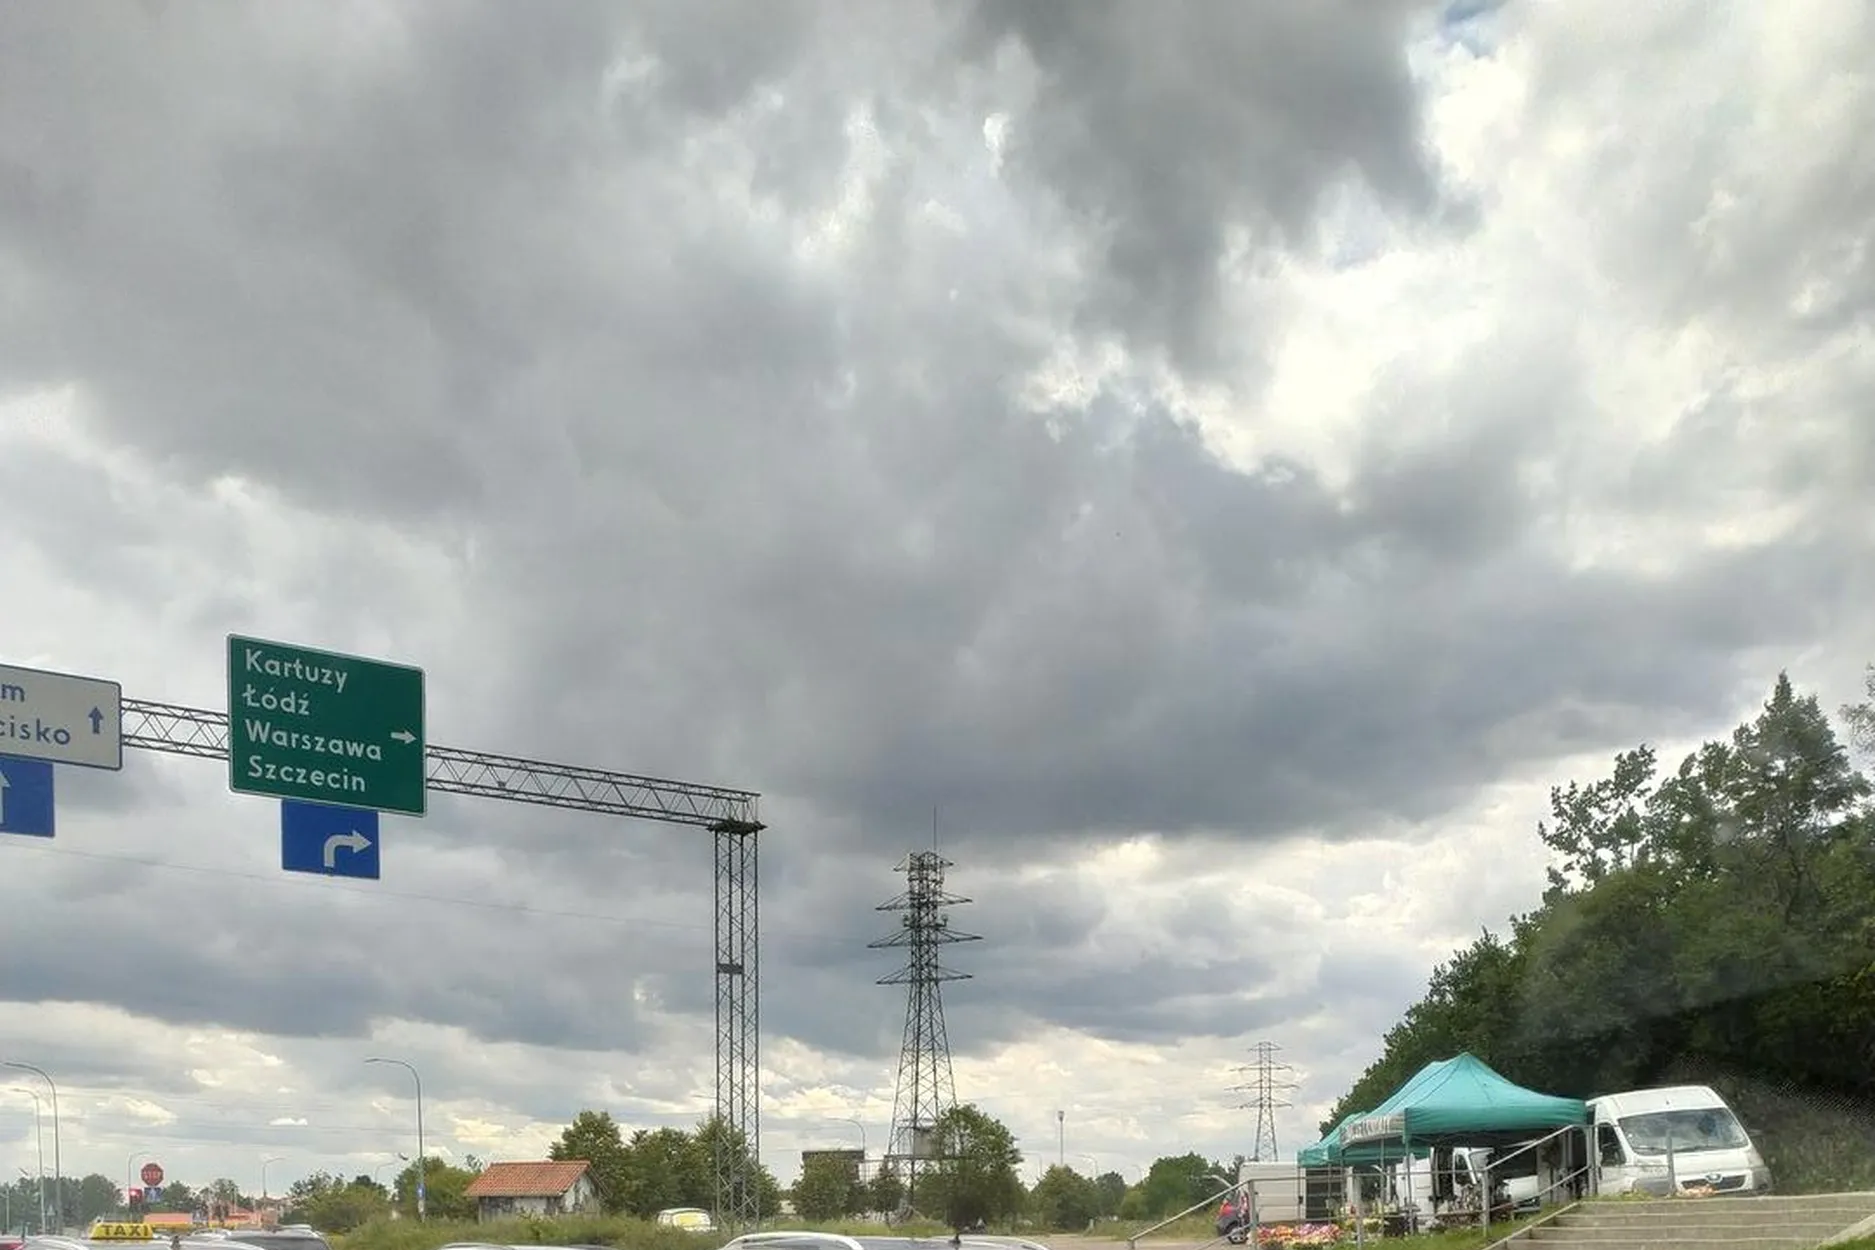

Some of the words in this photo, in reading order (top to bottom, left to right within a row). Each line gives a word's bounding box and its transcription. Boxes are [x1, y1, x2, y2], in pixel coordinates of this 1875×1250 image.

[245, 649, 347, 693] Kartuzy
[242, 684, 310, 715] Łódź
[245, 719, 382, 761] Warszawa
[248, 755, 365, 792] Szczecin
[101, 1225, 149, 1237] TAXI
